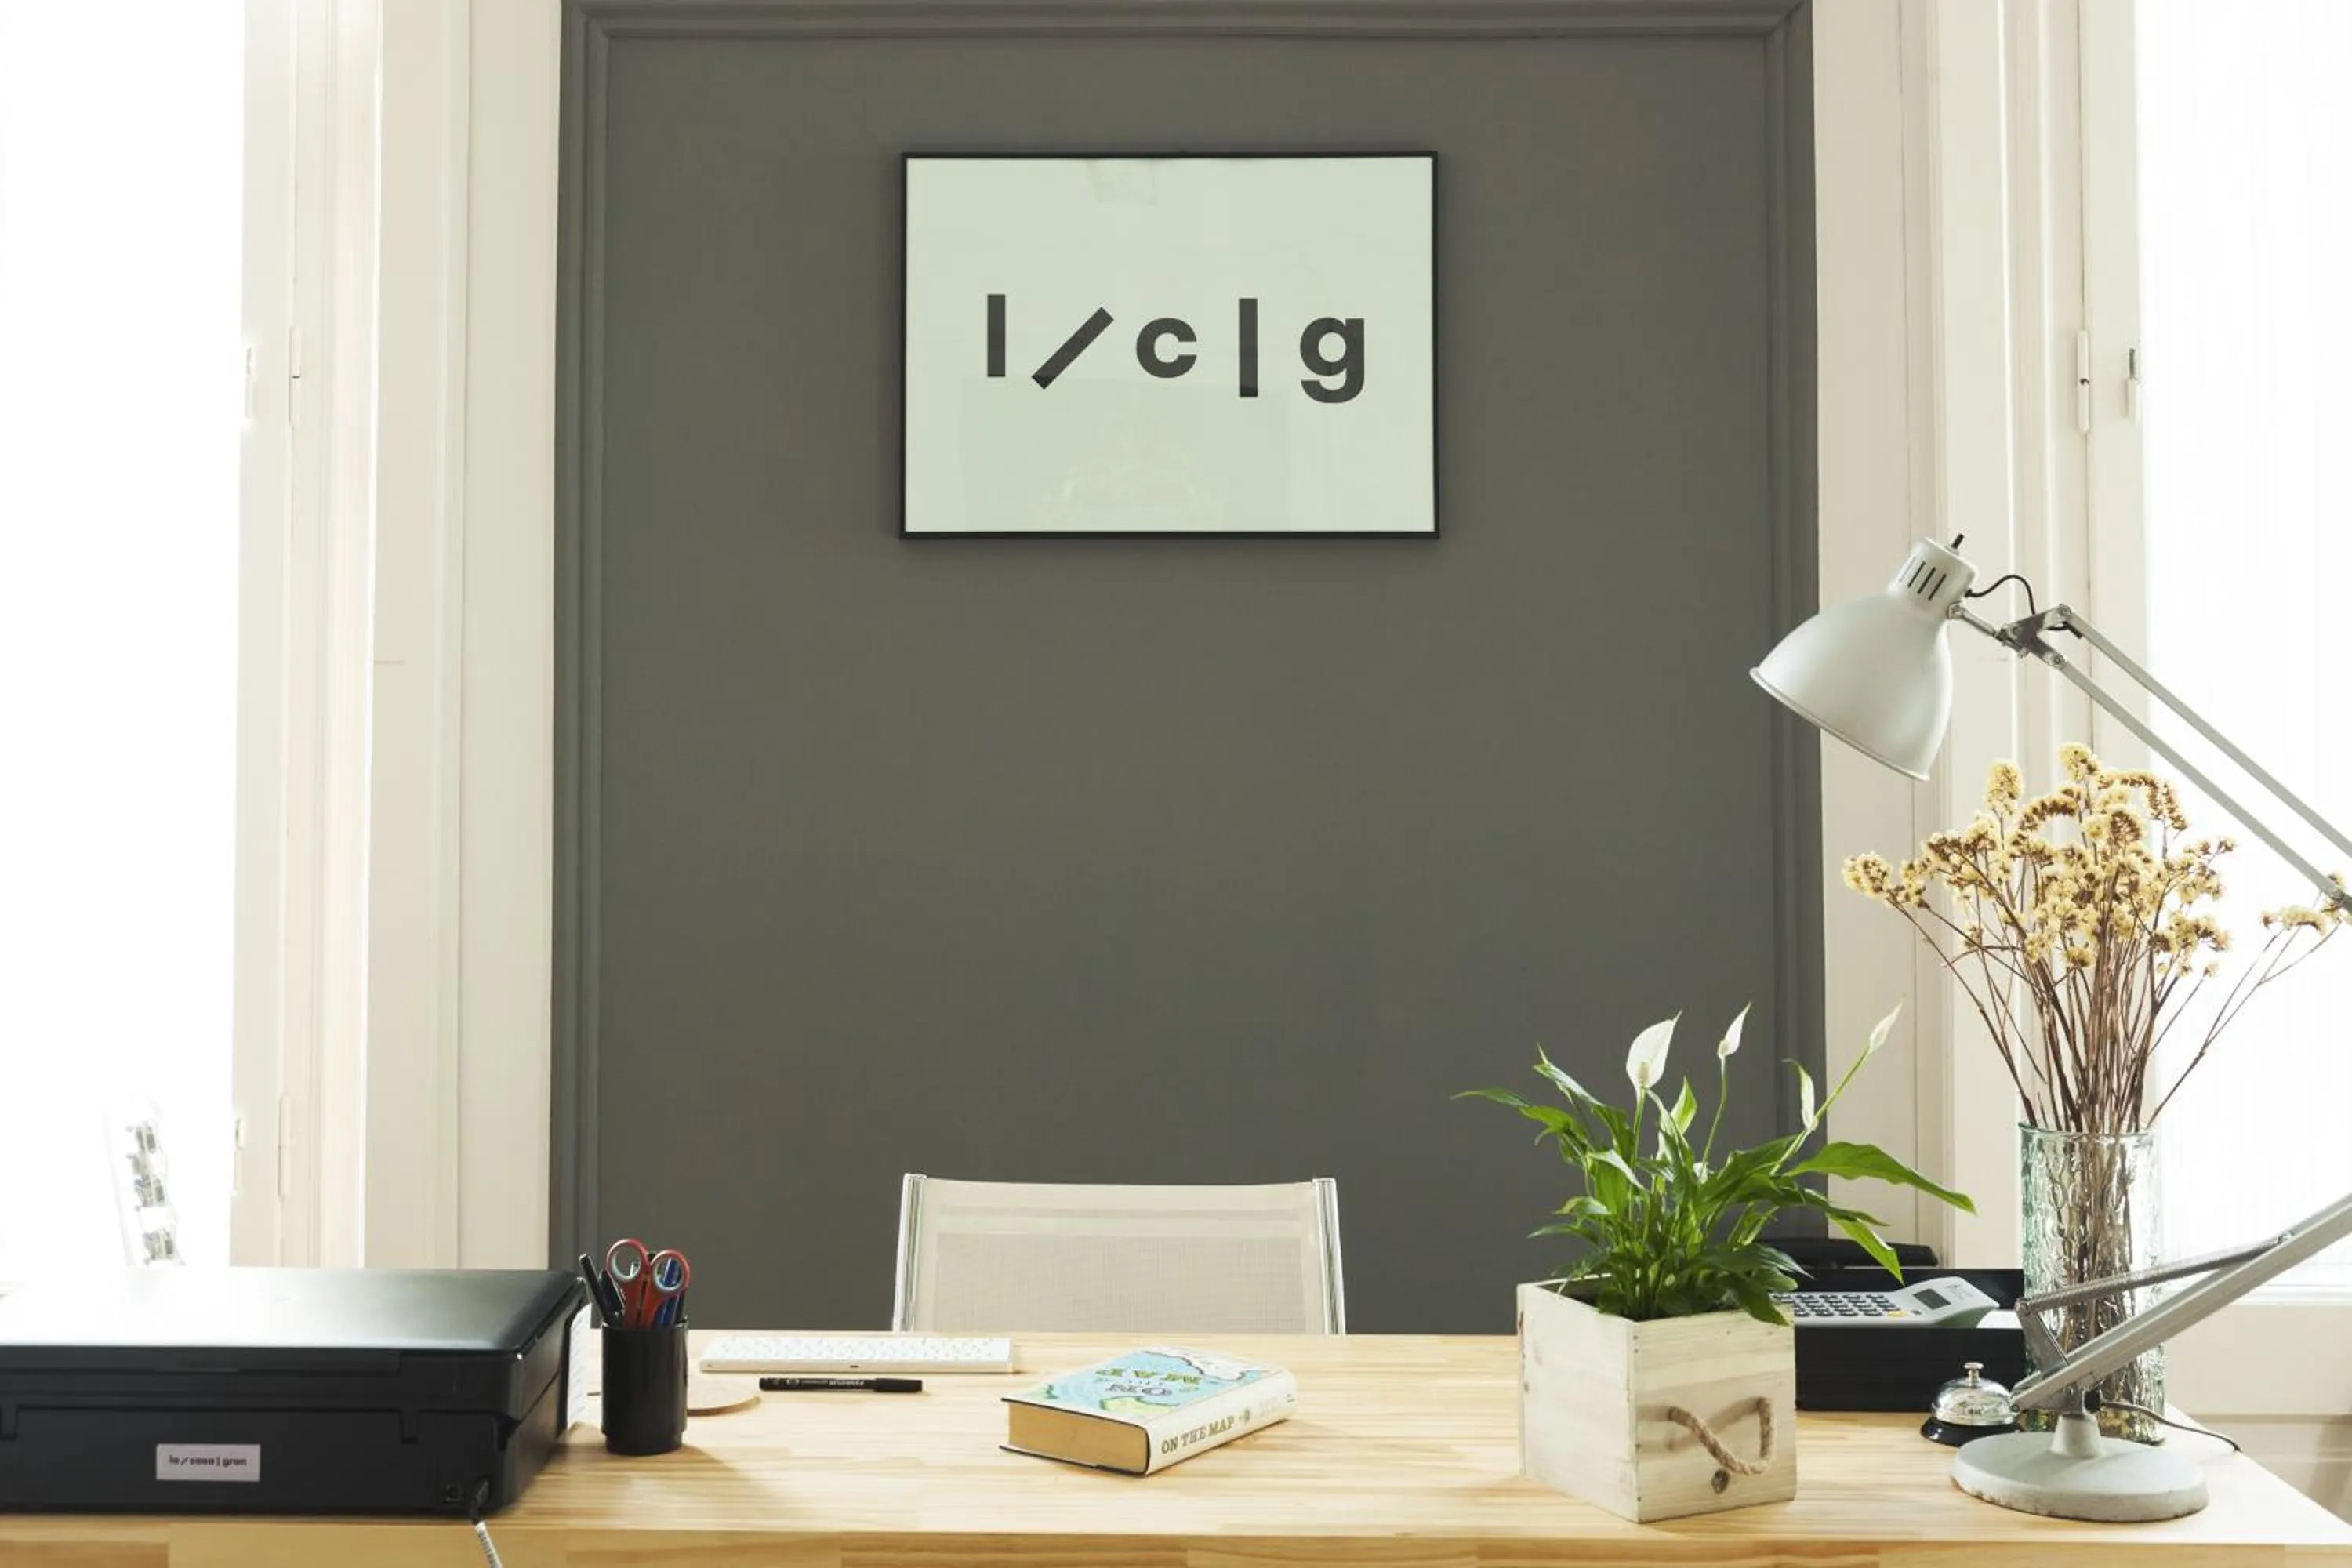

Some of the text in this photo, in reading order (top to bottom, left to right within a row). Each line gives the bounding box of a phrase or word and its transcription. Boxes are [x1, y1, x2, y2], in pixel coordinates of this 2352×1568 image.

[1161, 1416, 1235, 1454] ON THE MAP
